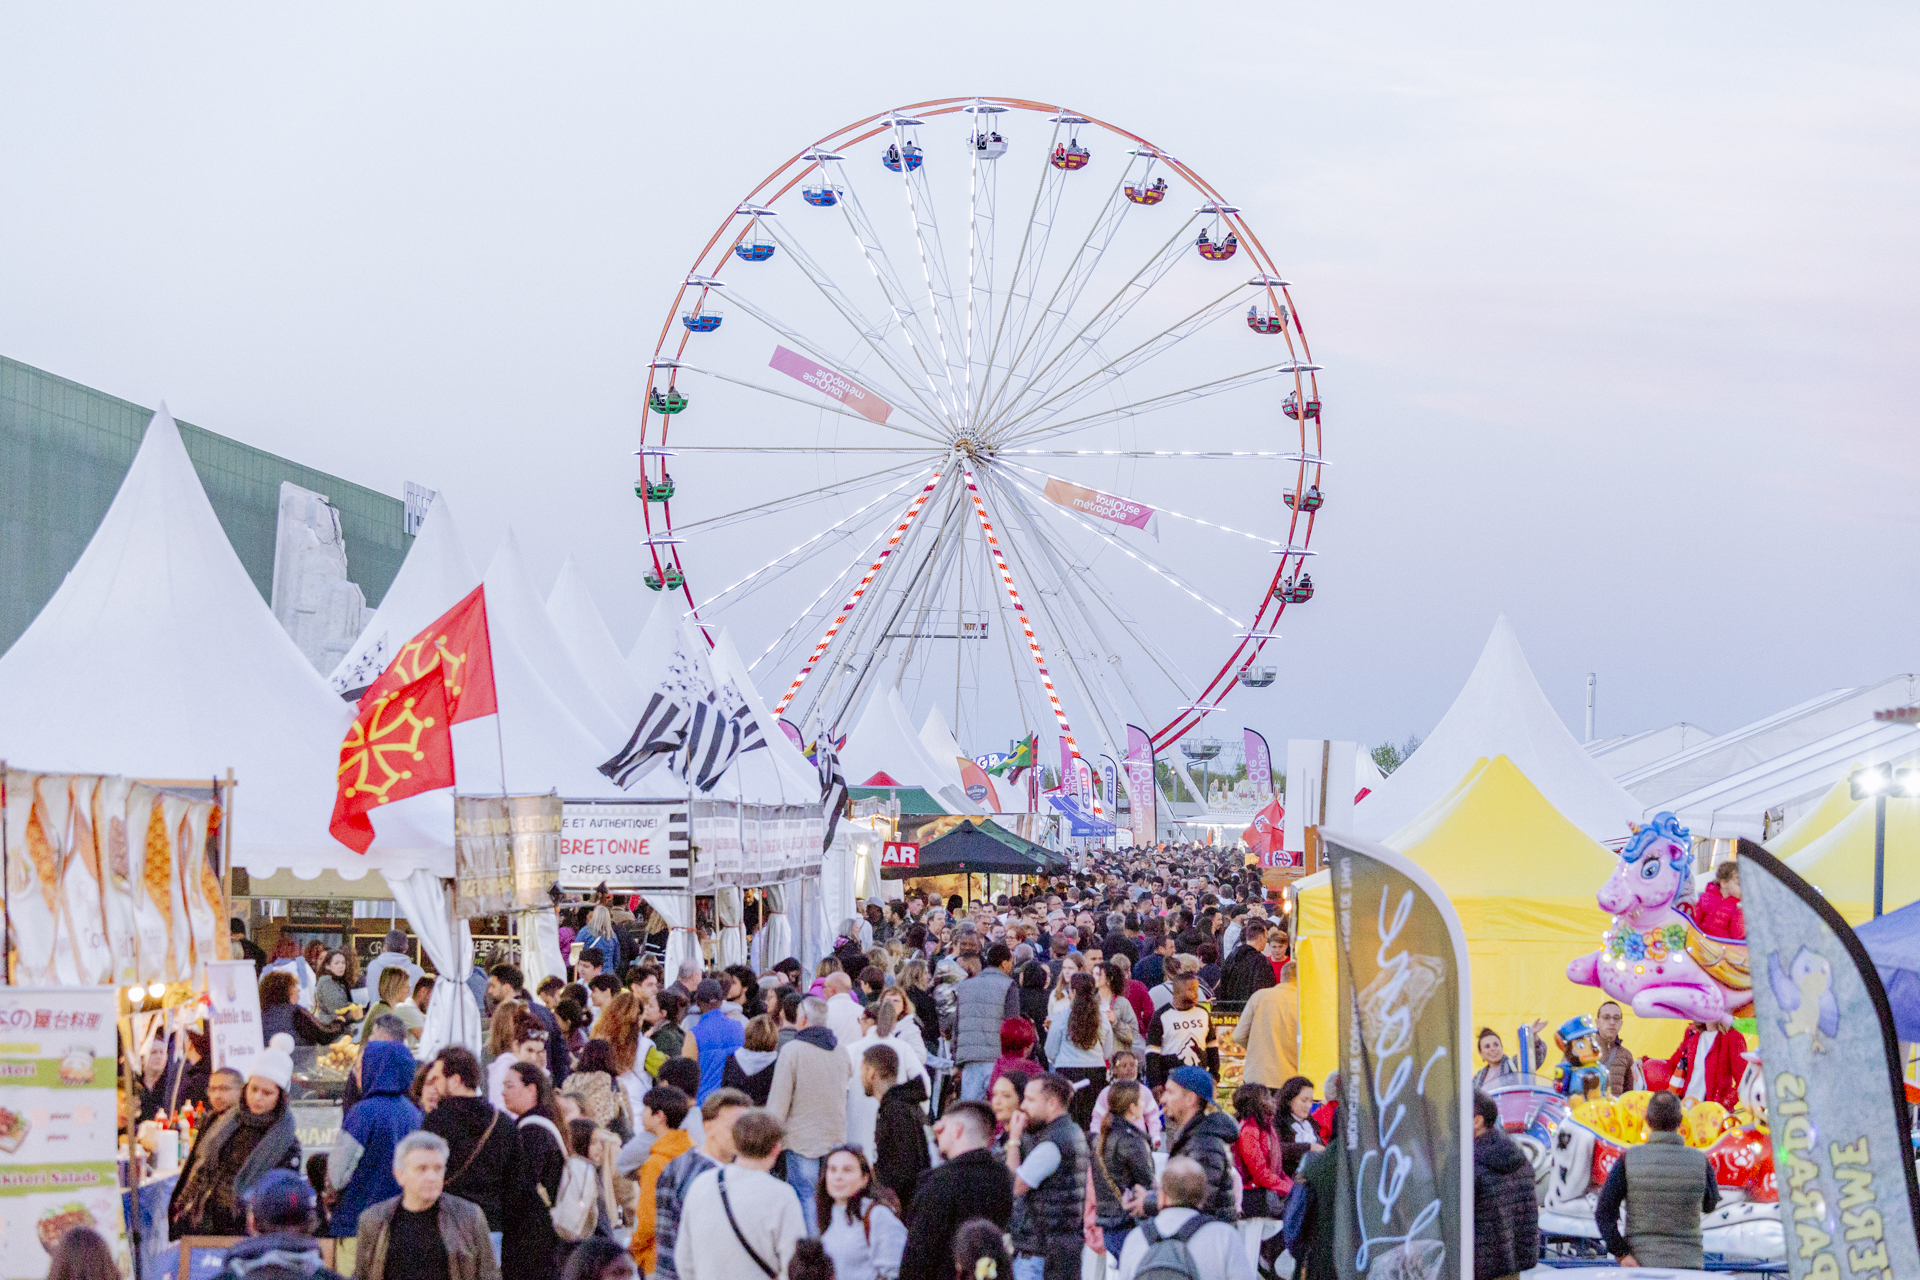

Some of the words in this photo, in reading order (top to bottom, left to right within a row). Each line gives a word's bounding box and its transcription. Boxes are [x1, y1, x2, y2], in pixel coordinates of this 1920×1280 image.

[572, 818, 585, 828] ET
[589, 818, 658, 829] AUTHENTIQUE!
[561, 838, 650, 855] BRETONNE
[1173, 1019, 1203, 1031] BOSS
